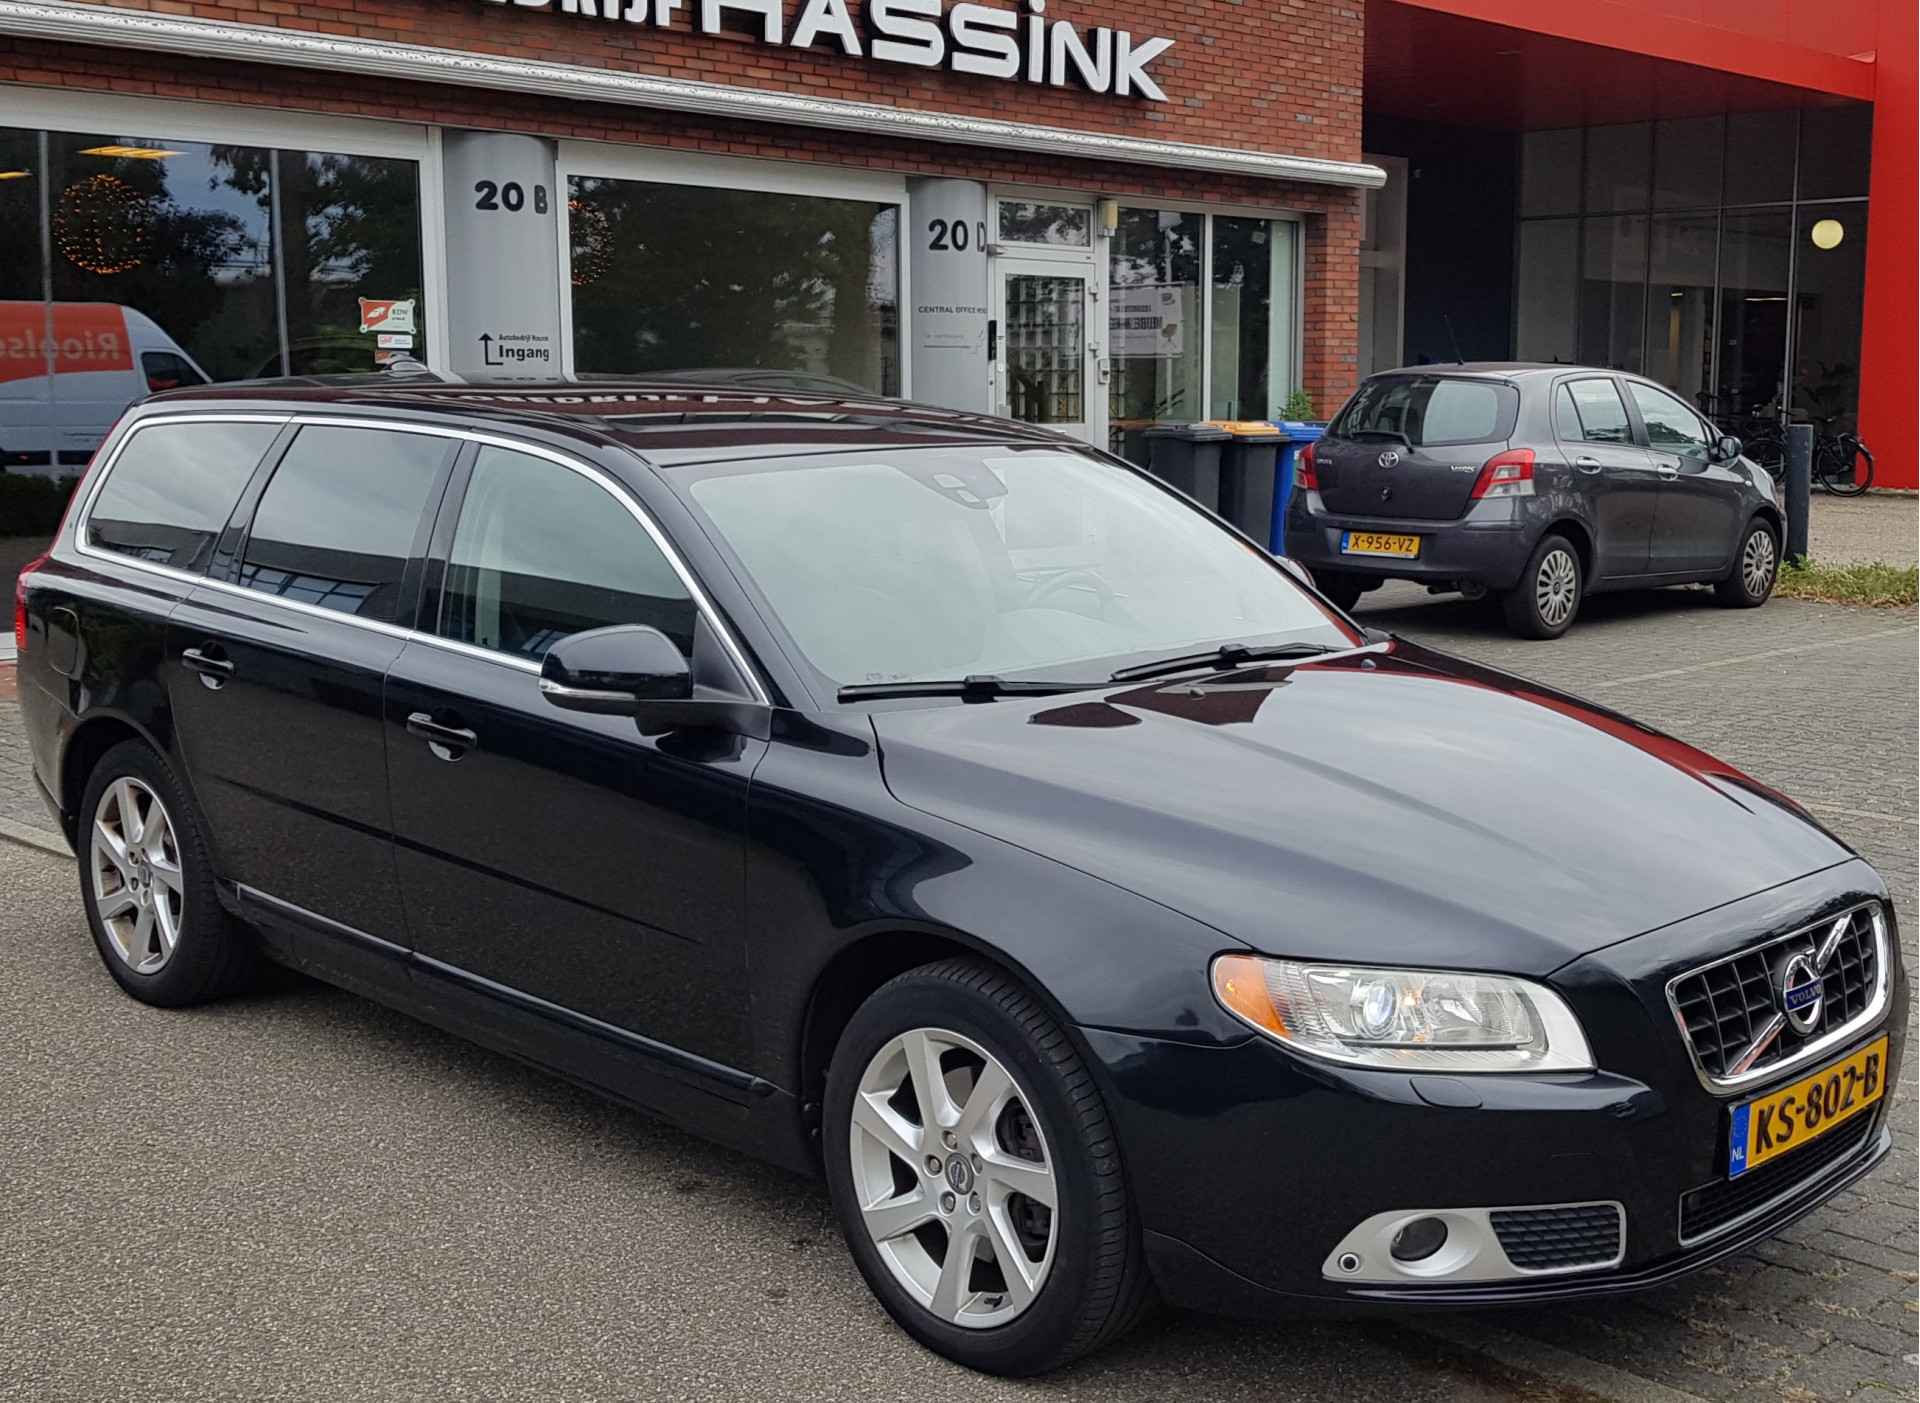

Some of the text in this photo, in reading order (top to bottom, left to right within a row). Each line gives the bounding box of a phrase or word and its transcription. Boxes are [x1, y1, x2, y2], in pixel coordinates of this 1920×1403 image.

[475, 180, 548, 214] 20 B
[928, 218, 968, 252] 20
[918, 305, 954, 314] CENTRAL
[499, 344, 550, 361] Ingang
[1351, 535, 1416, 552] X-956-VZ
[1789, 983, 1824, 1005] VOLVO
[1755, 1053, 1879, 1155] KS-802-B
[1731, 1147, 1744, 1161] NL
